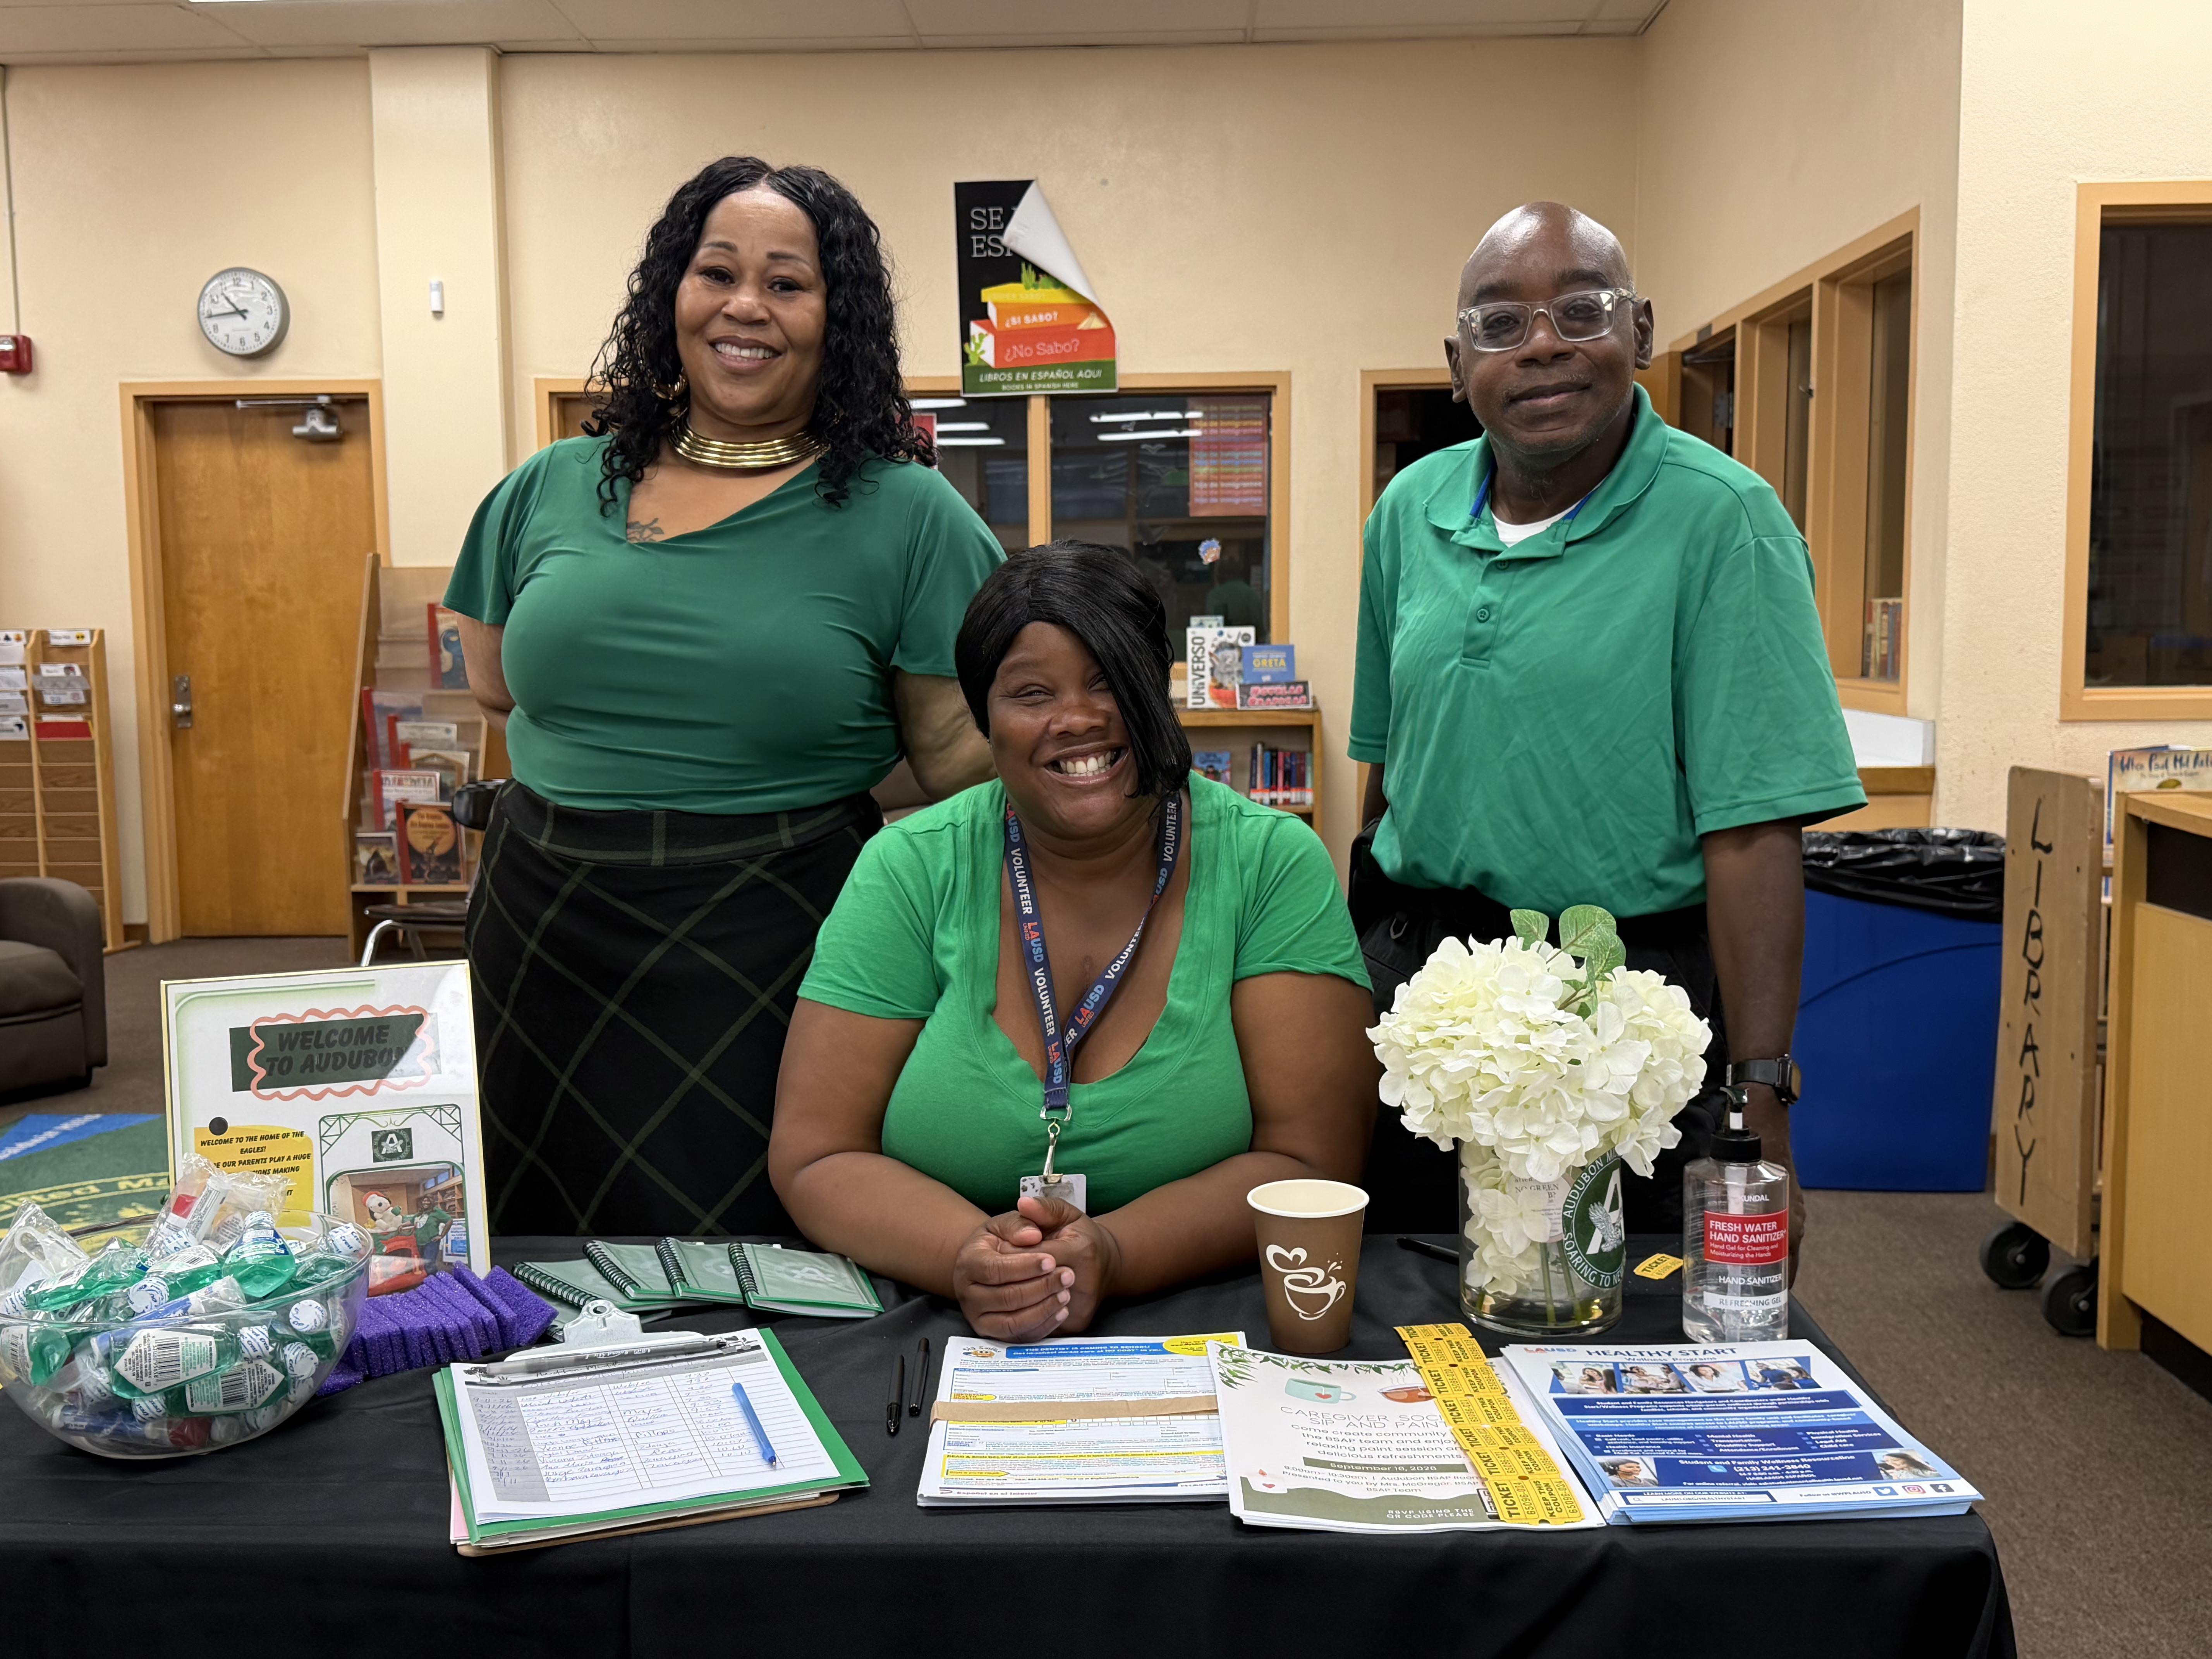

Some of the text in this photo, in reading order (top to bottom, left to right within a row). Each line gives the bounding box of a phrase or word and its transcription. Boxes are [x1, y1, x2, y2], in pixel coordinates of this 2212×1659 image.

[970, 206, 1004, 230] SE
[261, 292, 267, 301] 2
[267, 305, 273, 315] 3
[264, 321, 270, 330] 4
[224, 334, 230, 343] 7
[240, 337, 246, 346] 6
[254, 332, 260, 342] 5
[1005, 338, 1080, 362] ¿No Sabo?
[979, 372, 1013, 382] LIBROS
[1015, 372, 1028, 381] EN
[1031, 369, 1074, 381] ESPAÑOL
[1191, 636, 1205, 705] UNIVERSO
[1253, 659, 1286, 668] GRETA
[1010, 848, 1032, 915] VOLUNTEER
[1074, 801, 1176, 1025] LAUSD VOLUNTEER
[1027, 922, 1063, 1084] LAUSD VOLUNTEER LAUSD
[2014, 797, 2053, 1206] LIBRARY
[278, 1025, 390, 1052] WELCOME
[266, 1056, 293, 1076] TO
[201, 1138, 234, 1146] WELCOME
[240, 1146, 266, 1154] EAGLES!
[238, 1158, 267, 1166] PARENTS
[1563, 1158, 1604, 1218] AUDUBON
[1710, 1220, 1777, 1232] FRESH WATER
[1710, 1232, 1739, 1243] HAND
[1710, 1249, 1744, 1259] Moisturizing
[1747, 1244, 1769, 1252] Cleaning
[1564, 1232, 1610, 1287] SOARING TO
[1641, 1256, 1670, 1273] TICKET
[1719, 1273, 1782, 1285] HAND SANITIZER
[1772, 1296, 1781, 1305] GEL
[247, 1340, 258, 1352] Crest
[260, 1338, 269, 1351] Crest
[1455, 1341, 1469, 1360] COUPON
[1678, 1348, 1738, 1356] START
[1414, 1342, 1434, 1364] TICKET
[1427, 1369, 1449, 1394] TICKET
[1471, 1369, 1486, 1390] COUPON
[136, 1403, 149, 1416] Crest
[1280, 1407, 1390, 1422] CAREGIVER
[1443, 1399, 1465, 1424] TICKET
[1487, 1398, 1503, 1420] COUPON
[1291, 1424, 1329, 1433] Come
[1310, 1418, 1335, 1426] SIP
[1459, 1428, 1482, 1447] TICKET
[1504, 1428, 1521, 1444] COUPON
[1307, 1441, 1356, 1451] relaxing
[1317, 1449, 1374, 1459] delicious
[1513, 1449, 1535, 1474] KEEP THIS
[1522, 1451, 1542, 1472] COUPON
[1330, 1463, 1391, 1471] September
[1475, 1452, 1501, 1475] TICKET
[1283, 1471, 1331, 1482] Presented
[1494, 1482, 1521, 1518] TICKET
[1513, 1482, 1536, 1515] 65096-024
[1533, 1480, 1556, 1517] KEEP THIS
[1543, 1482, 1563, 1513] COUPON
[1554, 1480, 1578, 1514] 65096-024
